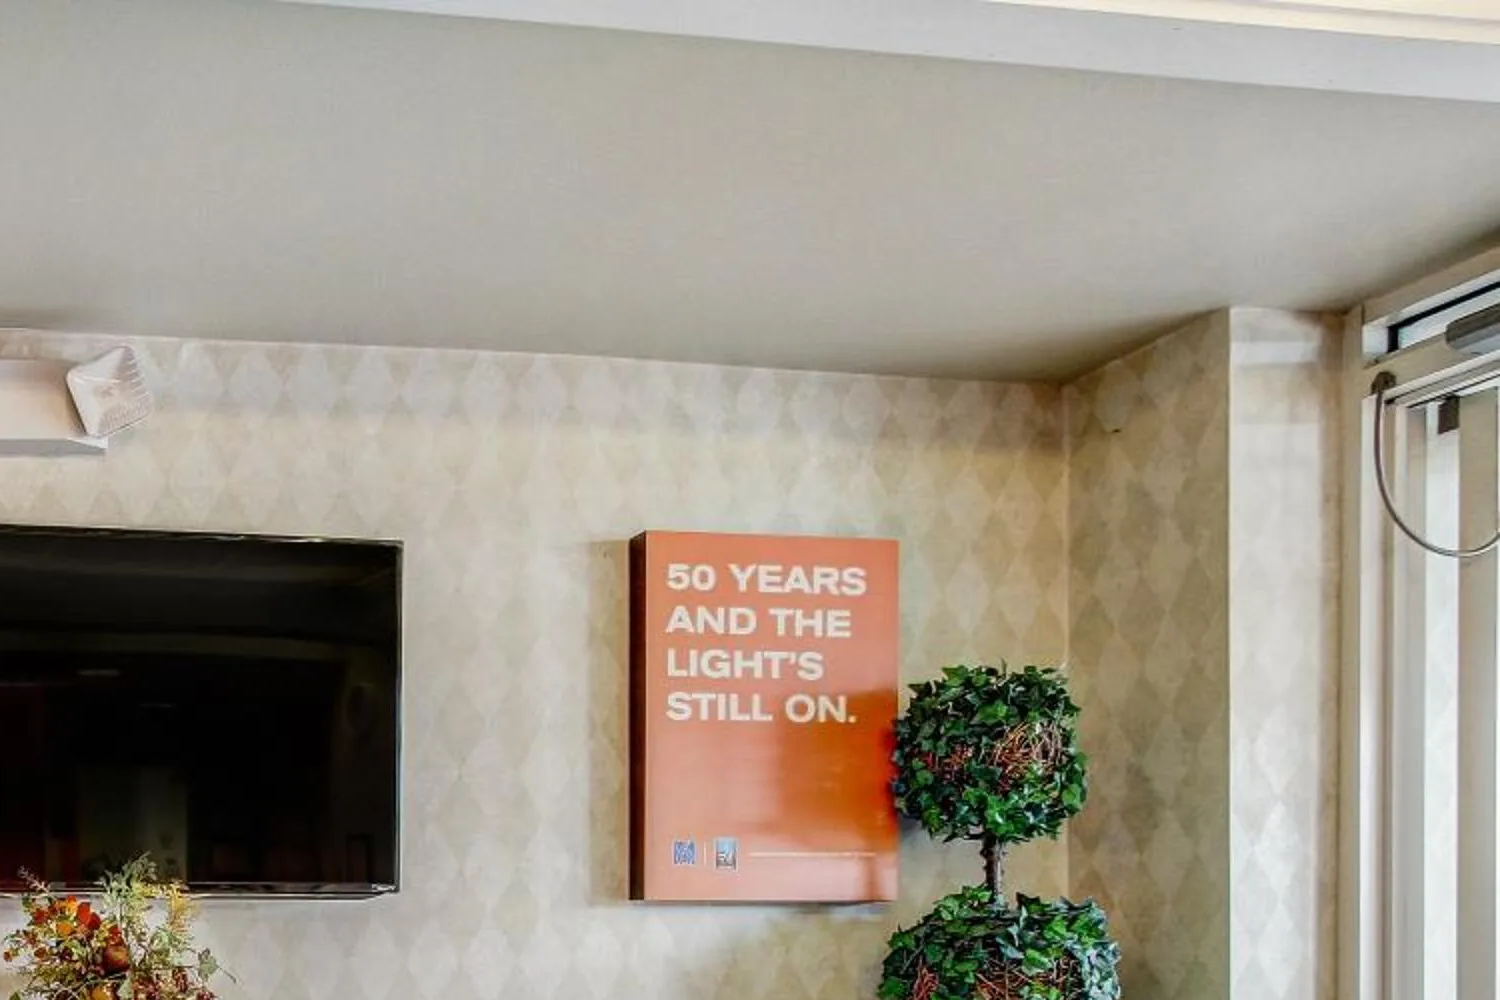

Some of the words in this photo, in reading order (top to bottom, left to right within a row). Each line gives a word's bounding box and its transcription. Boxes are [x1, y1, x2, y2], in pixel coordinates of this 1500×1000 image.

[667, 563, 717, 591] 50
[728, 563, 867, 596] YEARS
[665, 605, 757, 635] AND
[768, 607, 852, 638] THE
[667, 648, 825, 681] LIGHT'S
[666, 691, 773, 721] STILL
[785, 693, 857, 723] ON.
